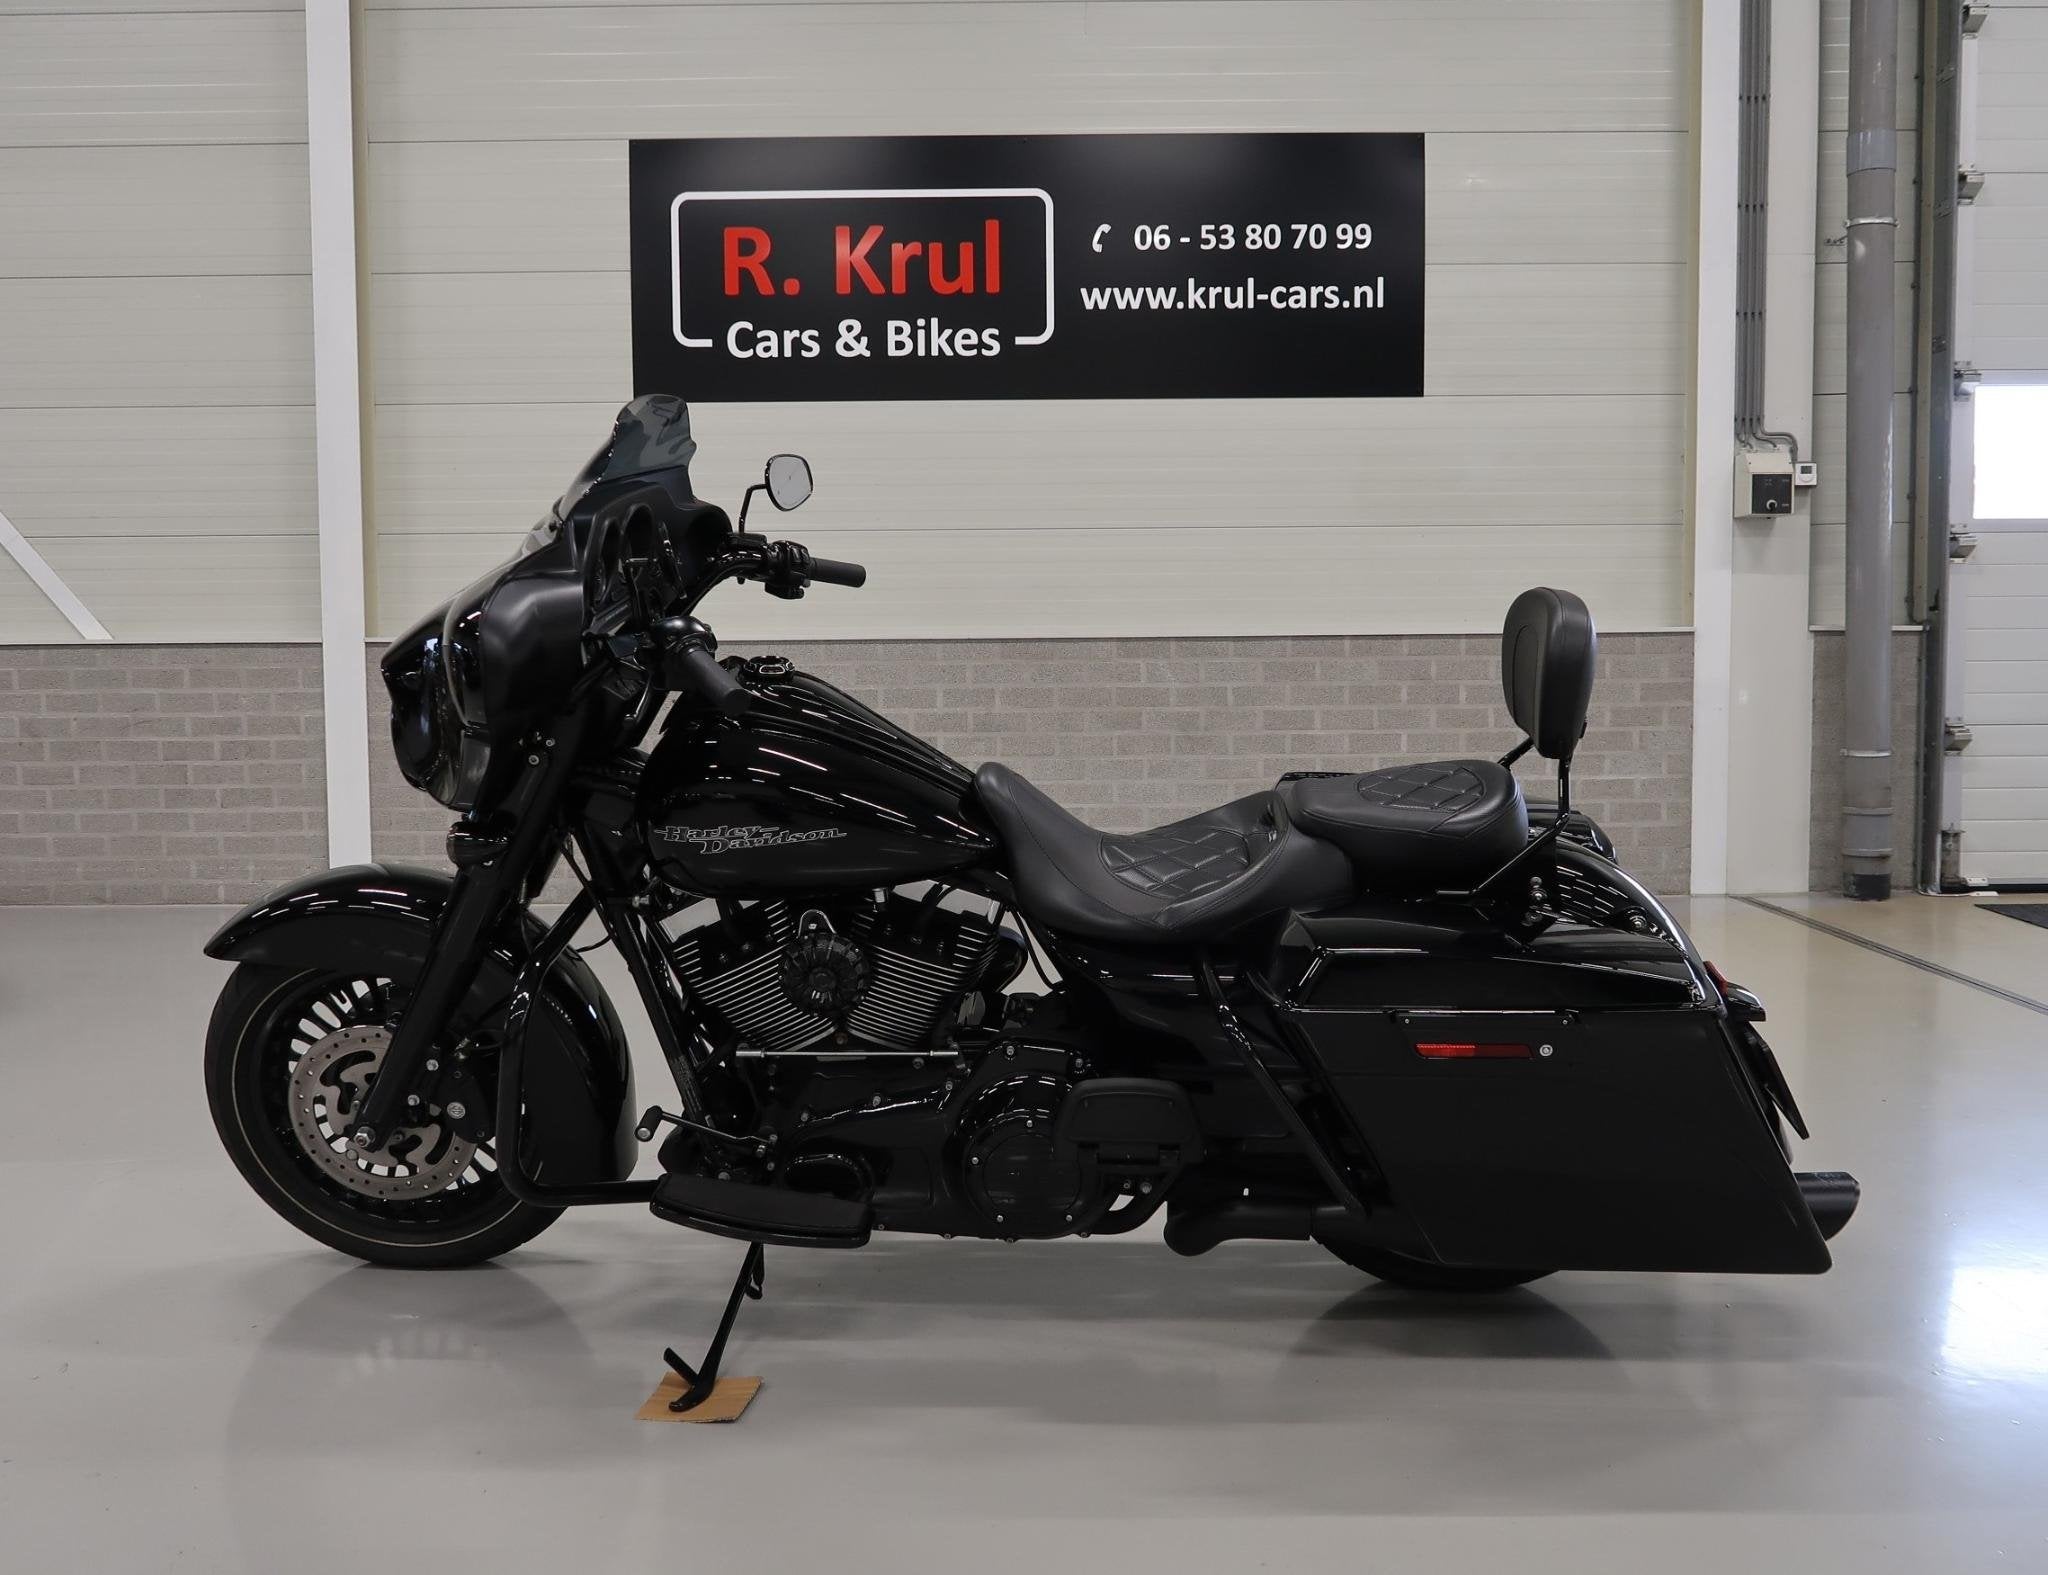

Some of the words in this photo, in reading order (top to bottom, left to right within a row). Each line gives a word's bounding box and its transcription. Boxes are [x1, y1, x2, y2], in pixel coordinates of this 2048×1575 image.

[1133, 224, 1171, 251] 06
[1199, 224, 1236, 250] 53
[1244, 223, 1282, 250] 80
[1290, 223, 1327, 250] 70
[1335, 223, 1372, 250] 99
[723, 226, 801, 297] R.
[834, 218, 1001, 296] Krul
[1079, 276, 1385, 311] www.krul-cars.nl
[726, 320, 821, 360] Cars
[835, 318, 871, 358] &
[886, 315, 1001, 358] Bikes
[688, 827, 848, 854] Davidson
